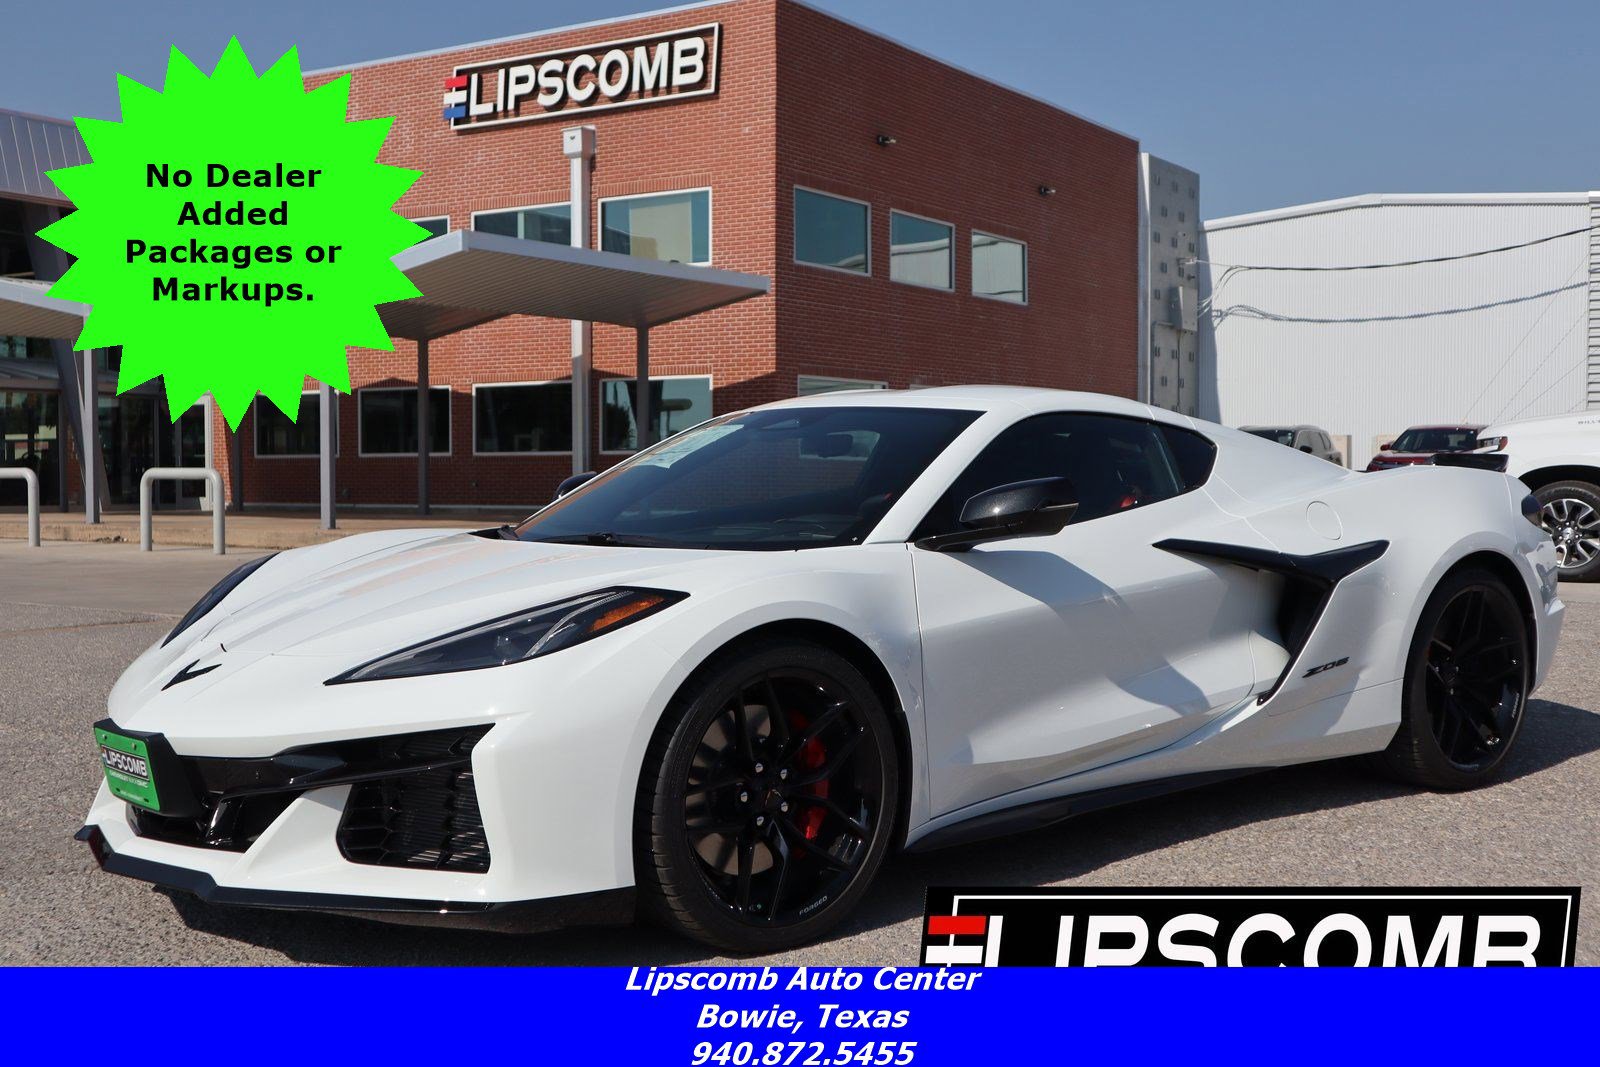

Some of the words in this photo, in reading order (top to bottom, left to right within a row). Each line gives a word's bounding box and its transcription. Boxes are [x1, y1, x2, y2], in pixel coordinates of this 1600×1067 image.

[469, 36, 705, 116] LIPSCOMB
[1302, 656, 1350, 679] Z06
[104, 749, 148, 777] LIPSCOMB
[799, 895, 828, 916] FORGED
